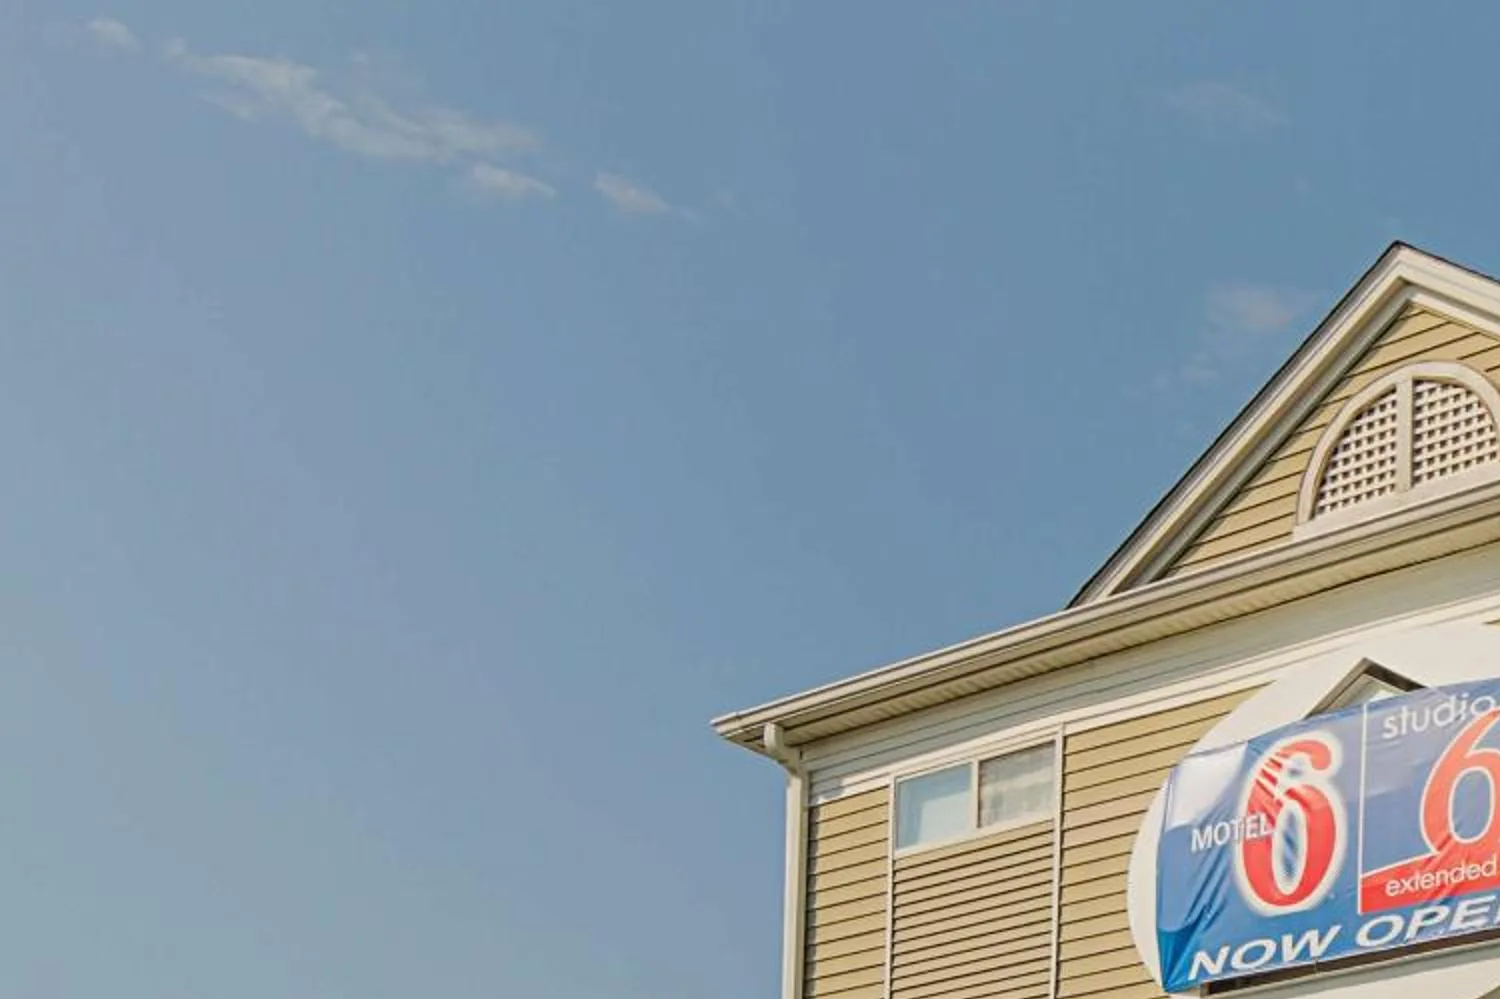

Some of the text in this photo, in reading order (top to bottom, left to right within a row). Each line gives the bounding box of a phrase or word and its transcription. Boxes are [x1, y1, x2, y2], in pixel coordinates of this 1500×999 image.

[1383, 692, 1497, 739] studio
[1191, 734, 1342, 912] MOTEL 6
[1385, 854, 1497, 897] extended
[1187, 925, 1342, 981] NOW
